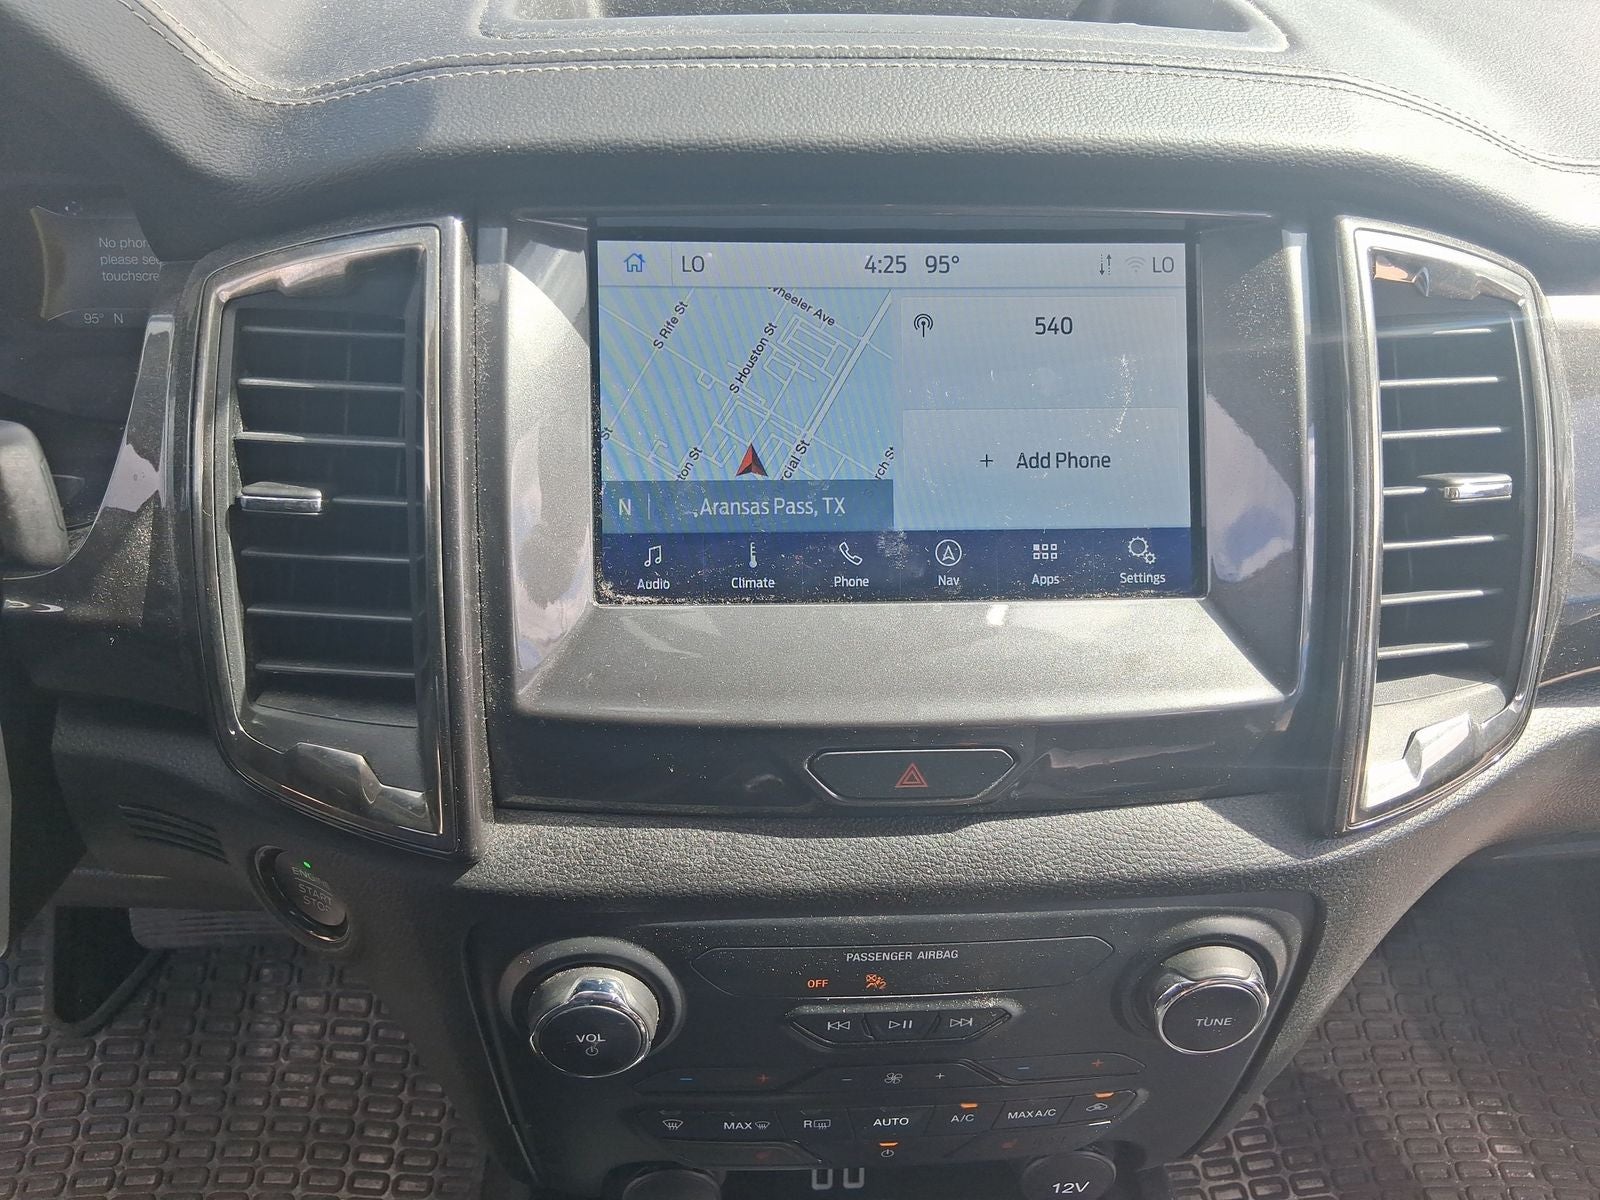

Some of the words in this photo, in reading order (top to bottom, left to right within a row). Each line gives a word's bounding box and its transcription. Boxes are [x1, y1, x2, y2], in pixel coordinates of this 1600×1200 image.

[98, 237, 117, 249] No
[100, 254, 138, 266] please
[681, 255, 705, 273] LO
[864, 255, 907, 274] 4:25
[924, 255, 960, 274] 95°
[1152, 256, 1175, 273] LO
[113, 313, 124, 324] N
[813, 308, 835, 326] Ave
[653, 339, 664, 350] S
[659, 316, 679, 339] Rife
[674, 301, 688, 315] St
[1034, 316, 1073, 335] 540
[729, 383, 740, 394] S
[735, 337, 769, 384] Houston
[764, 322, 777, 336] St
[796, 440, 810, 455] St
[676, 462, 694, 481] ton
[689, 447, 703, 461] St
[1016, 452, 1050, 469] Add
[1056, 452, 1111, 469] Phone
[619, 499, 631, 515] N
[774, 497, 819, 518] Pass,
[822, 497, 846, 515] TX
[637, 578, 670, 591] Audio
[731, 577, 775, 589] Climate
[834, 576, 869, 588] Phone
[938, 574, 960, 586] Nav
[1031, 573, 1060, 586] Apps
[1119, 571, 1166, 586] Settings
[846, 951, 912, 962] PASSENGER
[917, 950, 959, 959] AIRBAG
[807, 979, 829, 989] OFF
[1195, 1016, 1232, 1028] TUNE
[576, 1033, 606, 1043] VOL
[951, 1114, 975, 1123] A/C
[1008, 1111, 1033, 1120] MAX
[1035, 1109, 1057, 1117] A/C
[723, 1121, 752, 1130] MAX
[873, 1117, 909, 1127] AUTO
[1052, 1181, 1090, 1194] 12V
